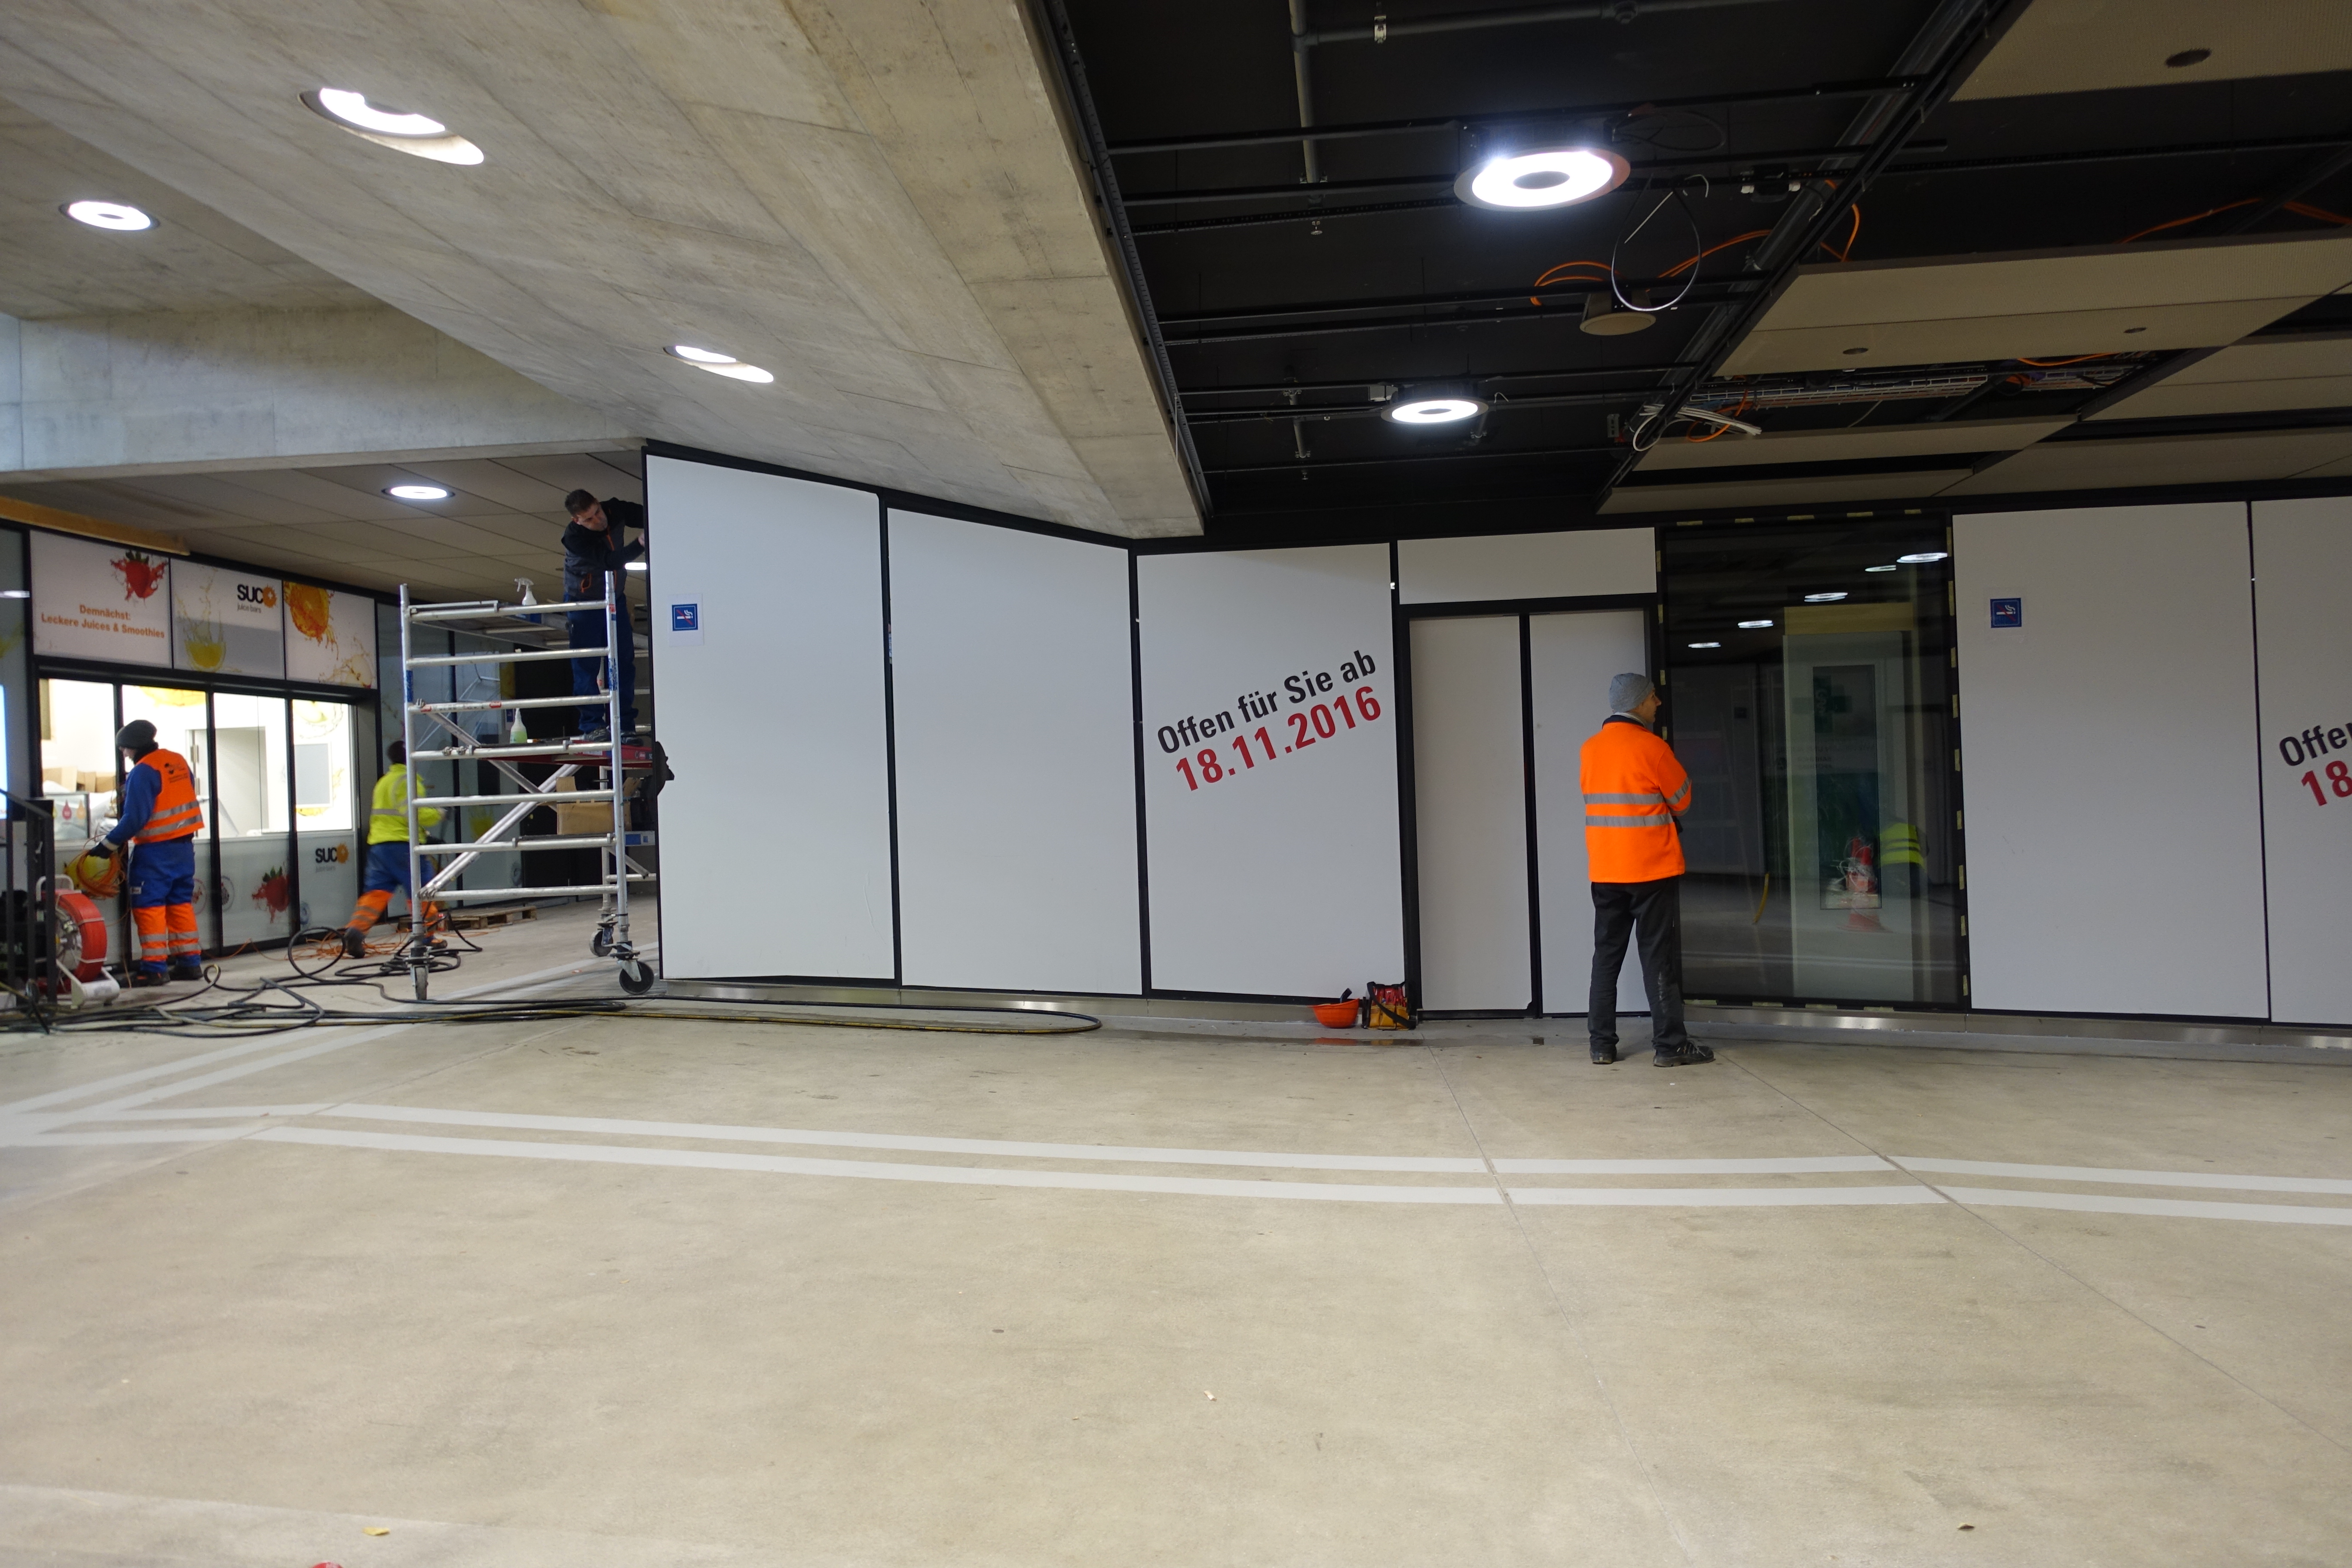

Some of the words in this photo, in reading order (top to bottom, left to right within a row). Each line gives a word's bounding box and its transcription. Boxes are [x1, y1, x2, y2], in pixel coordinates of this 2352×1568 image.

[41, 612, 79, 627] Leckere
[82, 619, 110, 632] Juices
[113, 623, 119, 632] &
[122, 624, 165, 639] Smoothies
[79, 604, 131, 620] Demnächst:
[1158, 711, 1235, 753] Offen
[1237, 691, 1278, 723] für
[1284, 671, 1333, 704] Sie
[1340, 650, 1376, 683] ab
[1176, 686, 1381, 791] 18.11.2016
